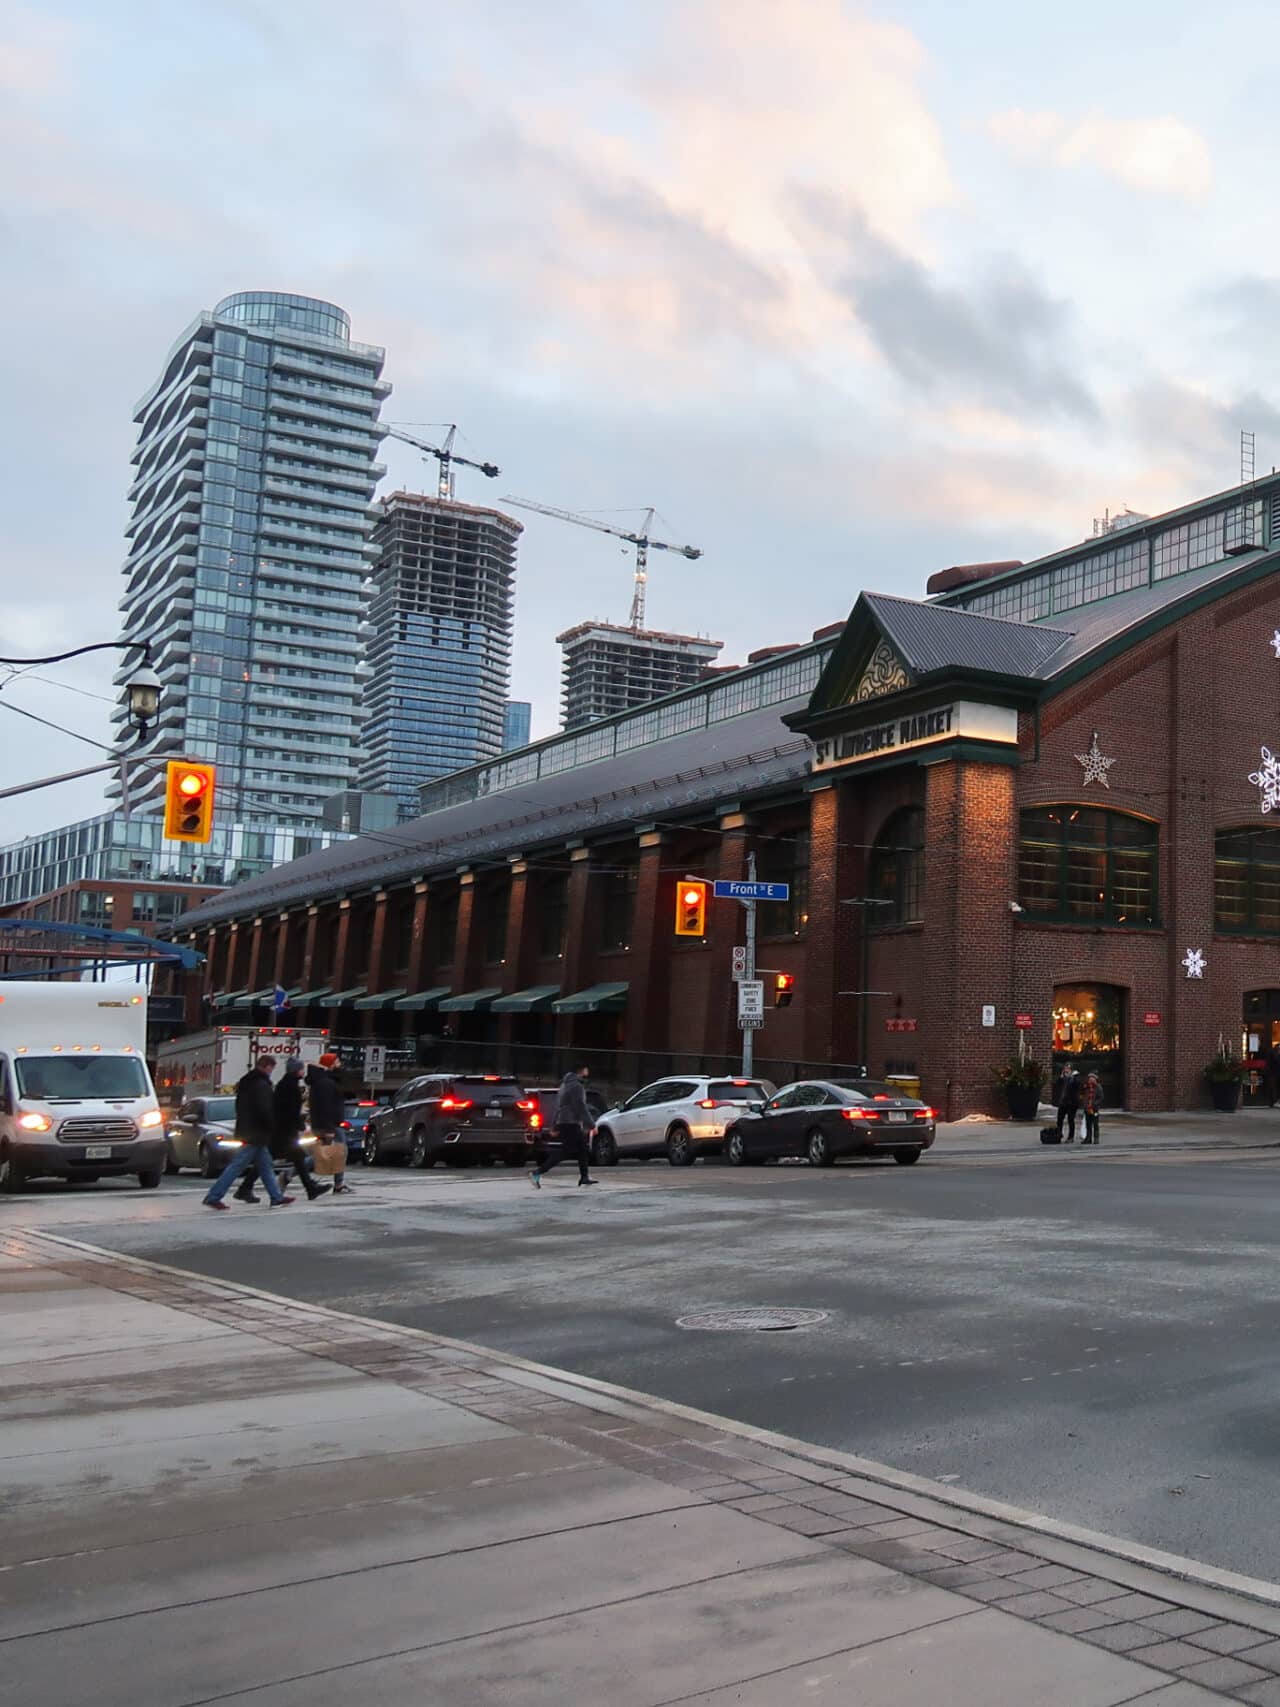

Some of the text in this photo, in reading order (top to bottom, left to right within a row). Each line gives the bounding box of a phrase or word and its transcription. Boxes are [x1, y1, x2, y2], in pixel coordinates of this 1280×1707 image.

[834, 724, 895, 761] LAWRENCE
[900, 706, 953, 745] MARKET
[730, 883, 757, 895] Front
[767, 885, 774, 896] E
[250, 1041, 300, 1055] Gordon
